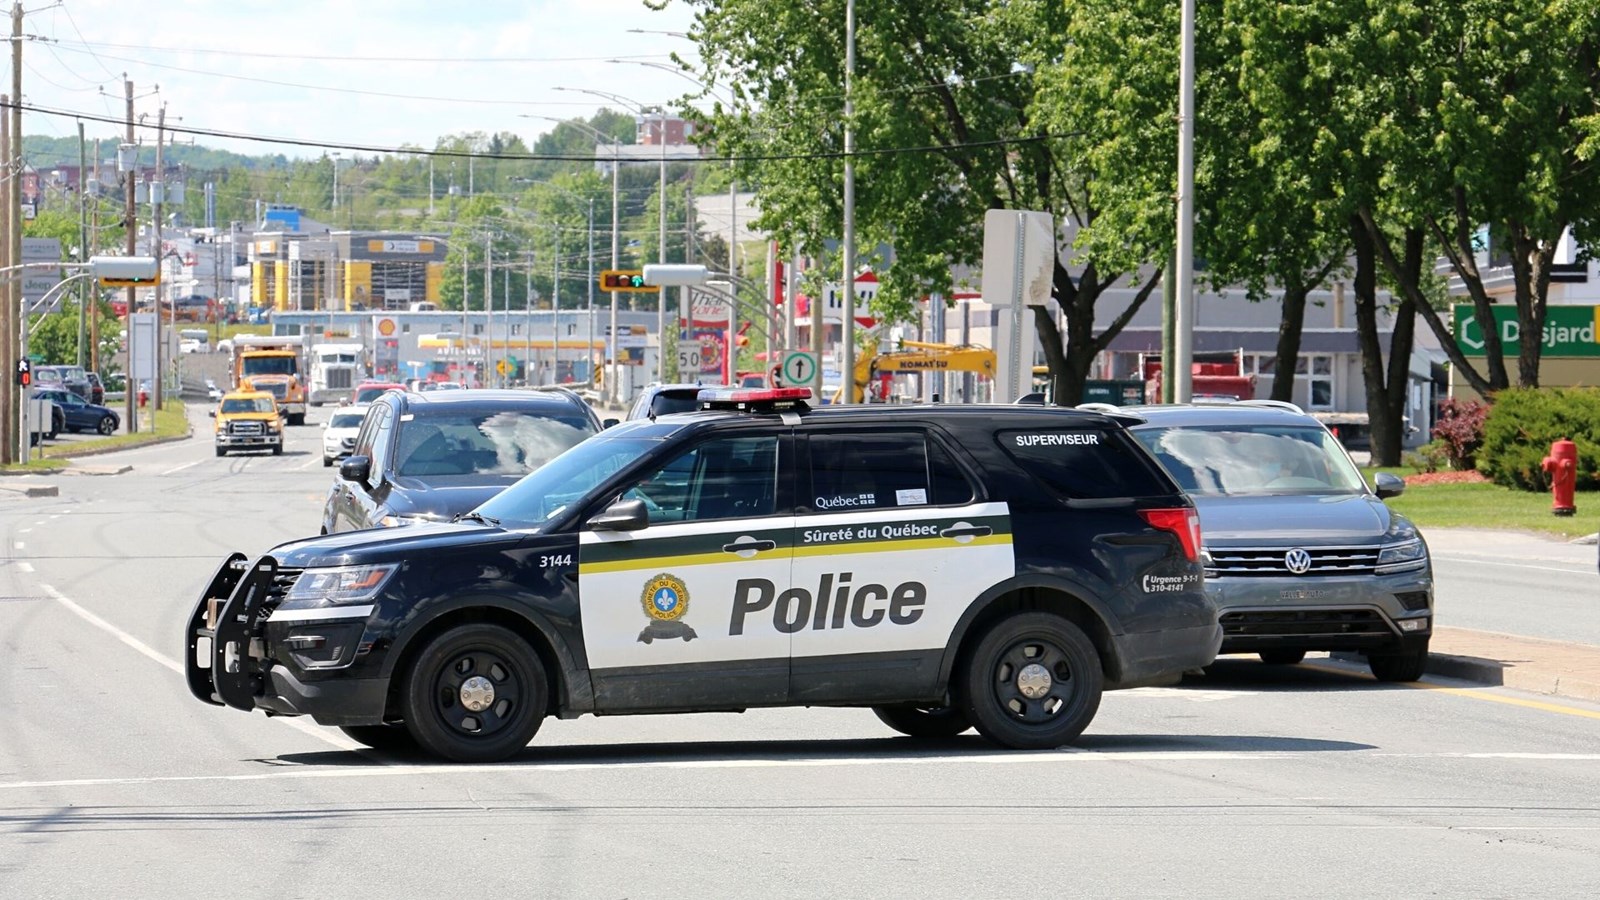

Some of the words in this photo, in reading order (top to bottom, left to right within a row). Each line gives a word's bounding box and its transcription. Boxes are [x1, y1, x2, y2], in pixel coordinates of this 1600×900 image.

[25, 281, 51, 291] Jeep
[1502, 320, 1595, 348] Dsjard
[680, 352, 699, 367] 50
[900, 361, 948, 369] KOMATSU
[1016, 434, 1099, 446] SUPERVISEUR
[815, 496, 860, 509] Québec
[804, 527, 853, 543] Sûreté
[857, 527, 877, 539] du
[881, 524, 938, 539] Québec
[539, 554, 572, 568] 3144
[1150, 575, 1182, 585] Urgence
[1182, 574, 1199, 583] 9-1-1
[1150, 584, 1184, 592] 310-4141
[729, 572, 927, 636] Police
[655, 610, 677, 619] POLICE
